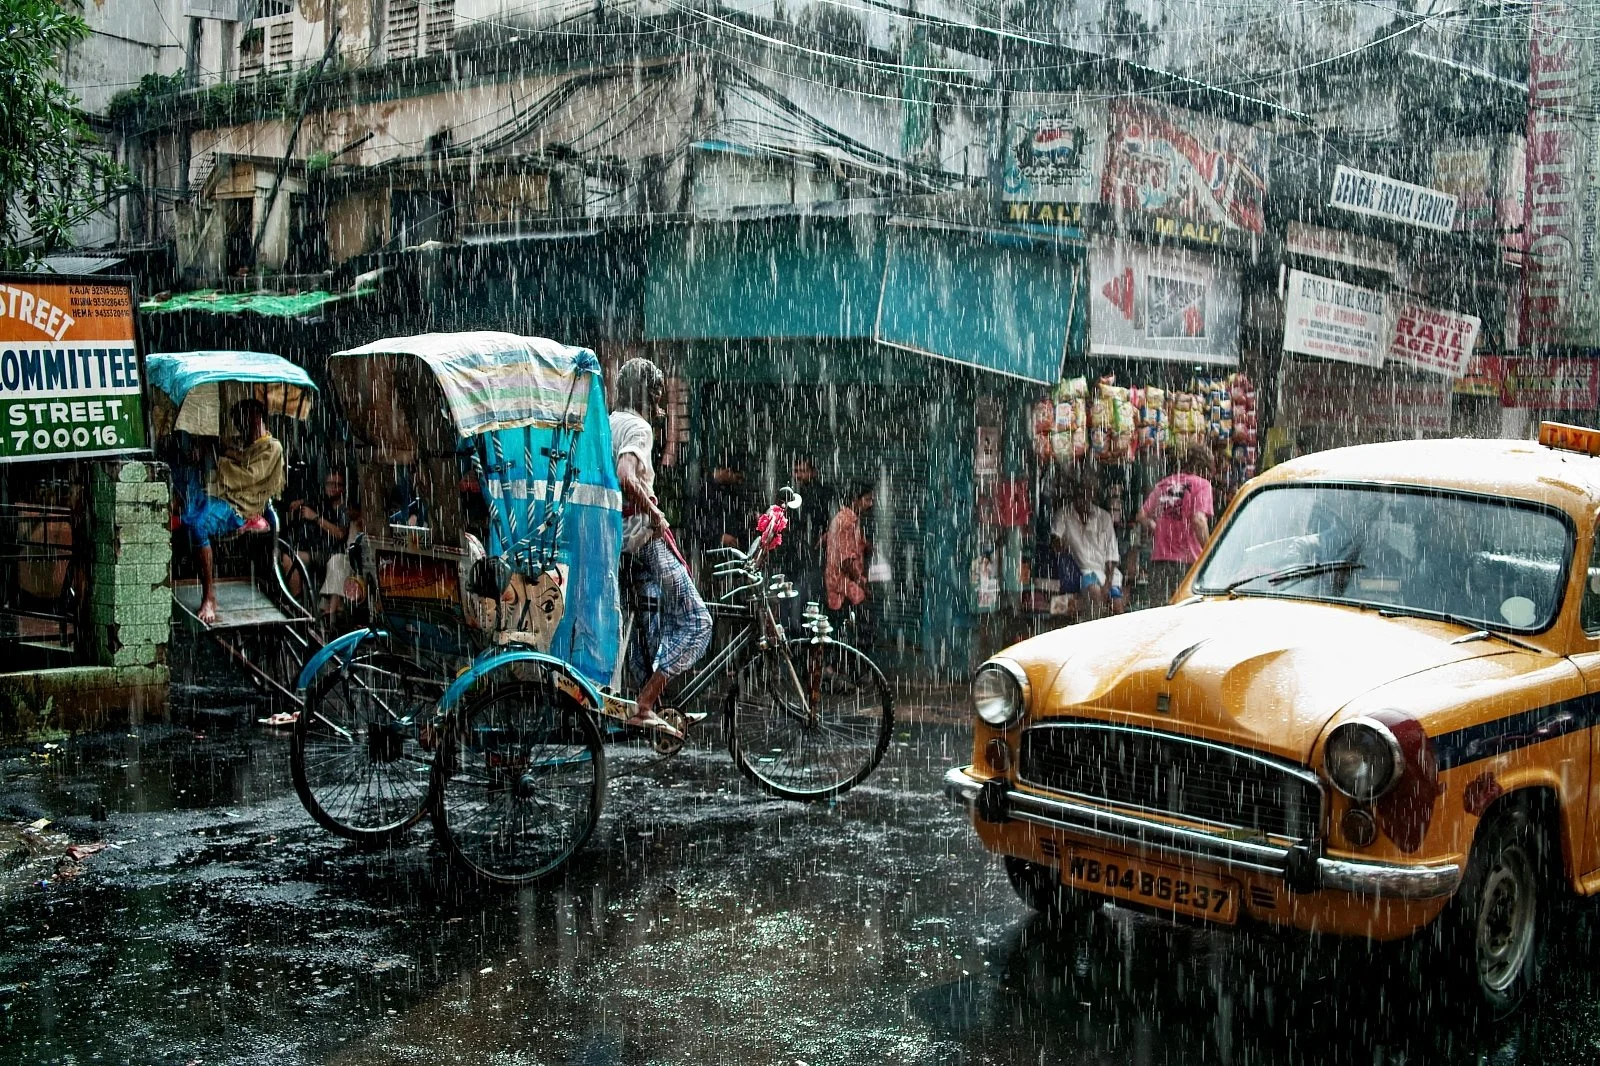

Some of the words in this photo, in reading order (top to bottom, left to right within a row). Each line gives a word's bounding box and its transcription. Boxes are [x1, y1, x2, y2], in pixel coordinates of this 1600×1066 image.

[1335, 172, 1377, 209] BENGAL
[1378, 182, 1415, 218] TRAVEL
[1414, 192, 1454, 228] SERVICE
[1394, 334, 1463, 363] AGENT
[0, 348, 138, 391] OMMITTEE
[8, 400, 129, 426] STREET,
[1546, 427, 1594, 451] TAXI
